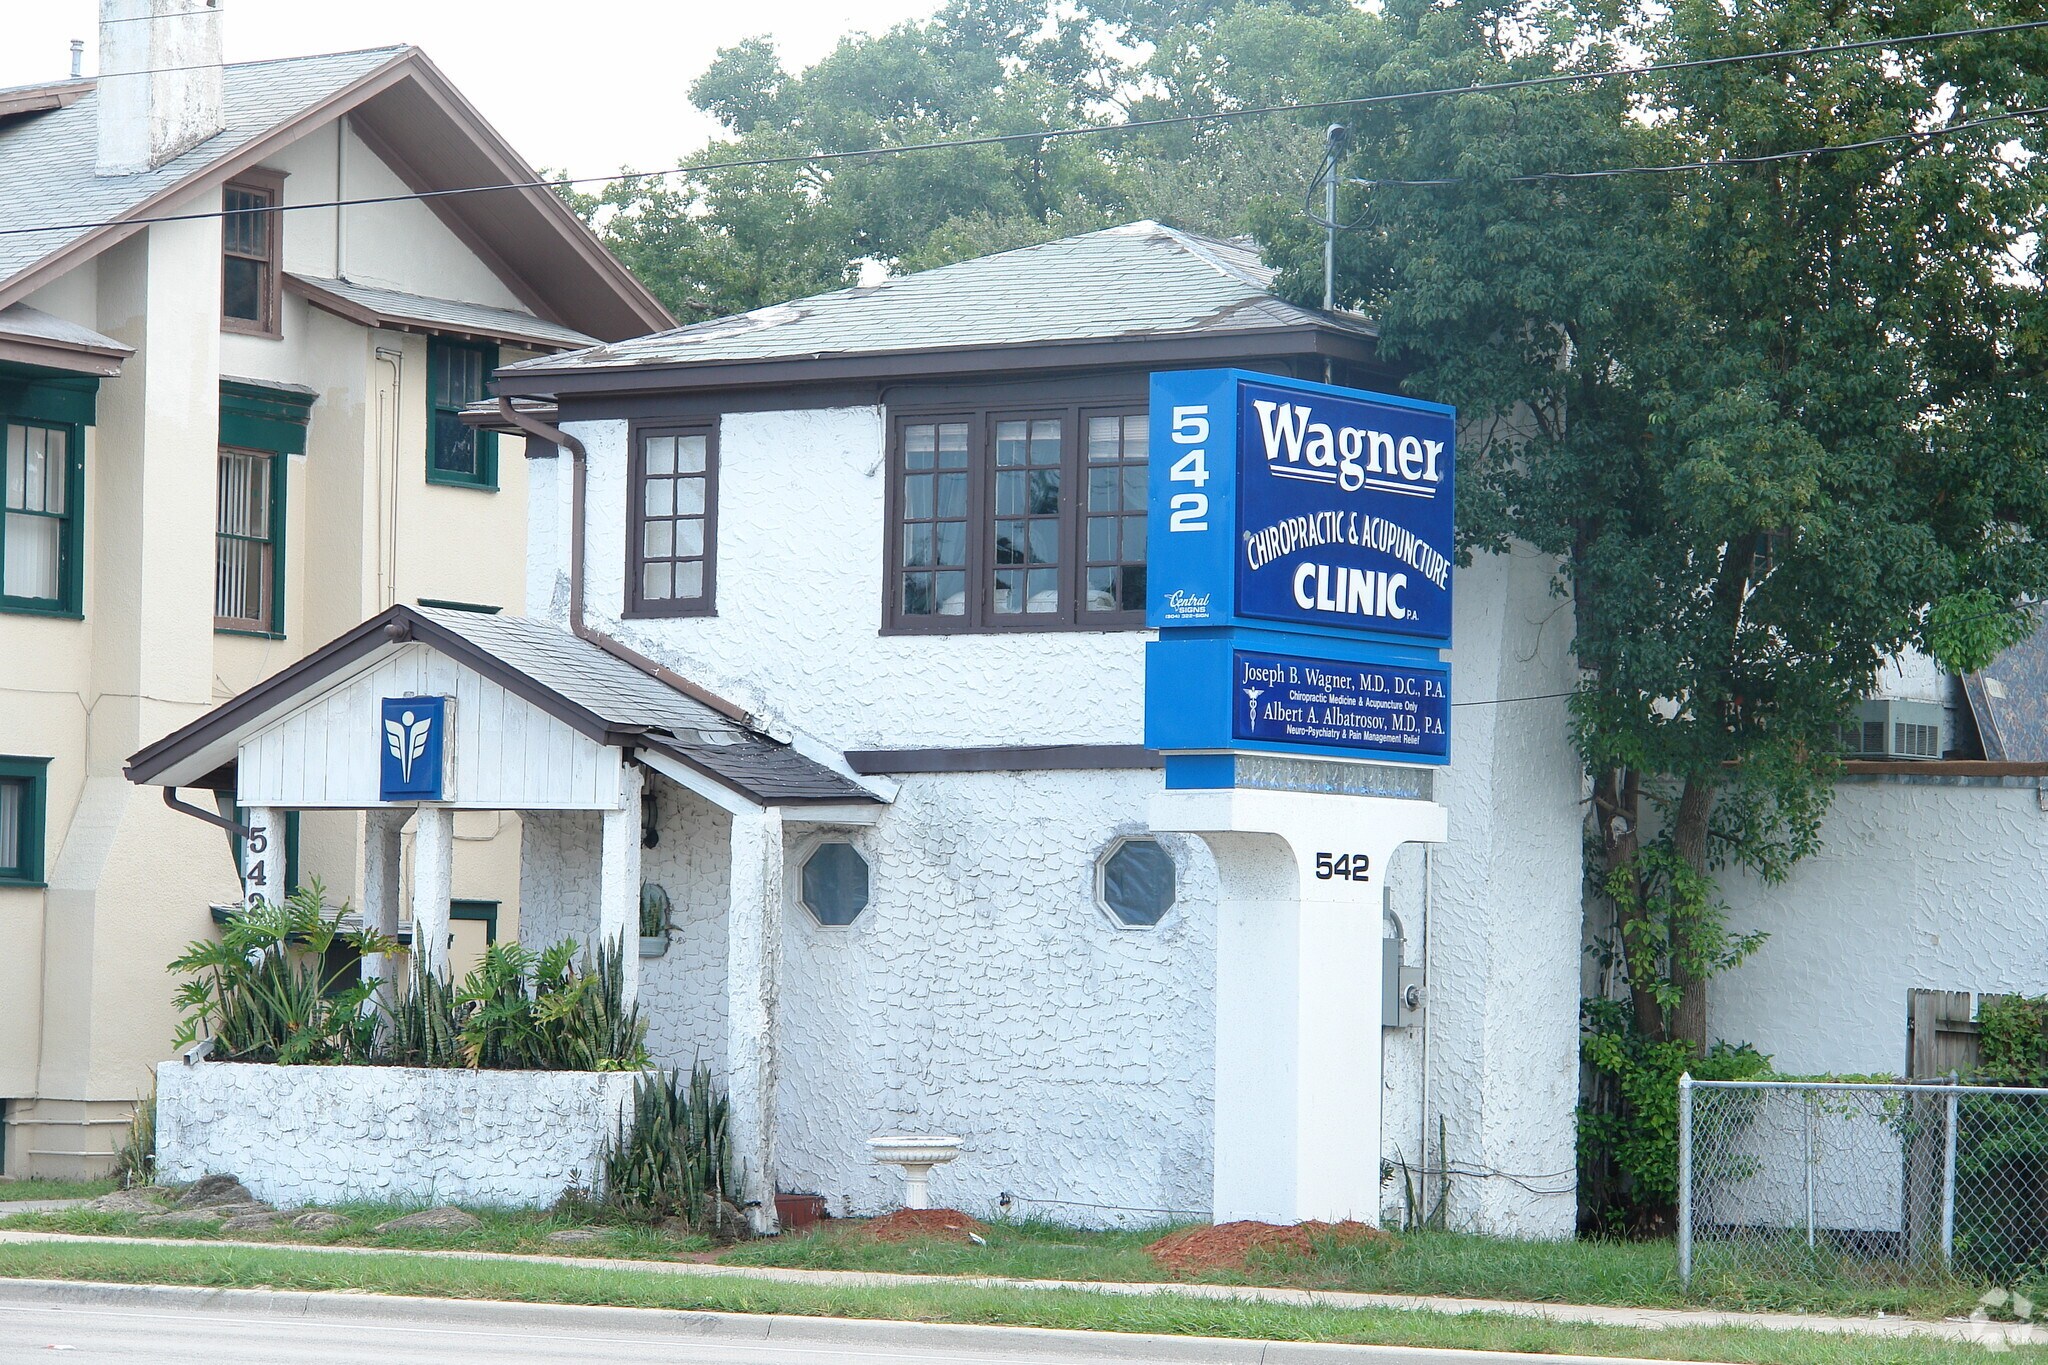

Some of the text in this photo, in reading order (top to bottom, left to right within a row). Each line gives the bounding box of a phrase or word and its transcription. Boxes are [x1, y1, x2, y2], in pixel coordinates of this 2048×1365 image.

[1253, 399, 1444, 491] Wagner
[1169, 405, 1210, 532] 542
[1246, 511, 1451, 590] CHIROPRACTIC & ACUPUNCTURE
[1170, 589, 1210, 607] Central
[1293, 562, 1420, 621] CLINIC P.A.
[1242, 662, 1285, 687] Joseph
[1289, 666, 1301, 684] B.
[1305, 668, 1355, 693] Wagner,
[1359, 673, 1390, 694] M.D.,
[1424, 679, 1446, 698] P.A.
[1263, 702, 1445, 734] Albert A. Albatrosov, M.D., P.A.
[1289, 689, 1418, 713] Chiropractic Medicine & Acupuncture Only
[1286, 724, 1420, 745] Neuro-Psychiatry & Pain Management Relief
[1316, 852, 1369, 881] 542
